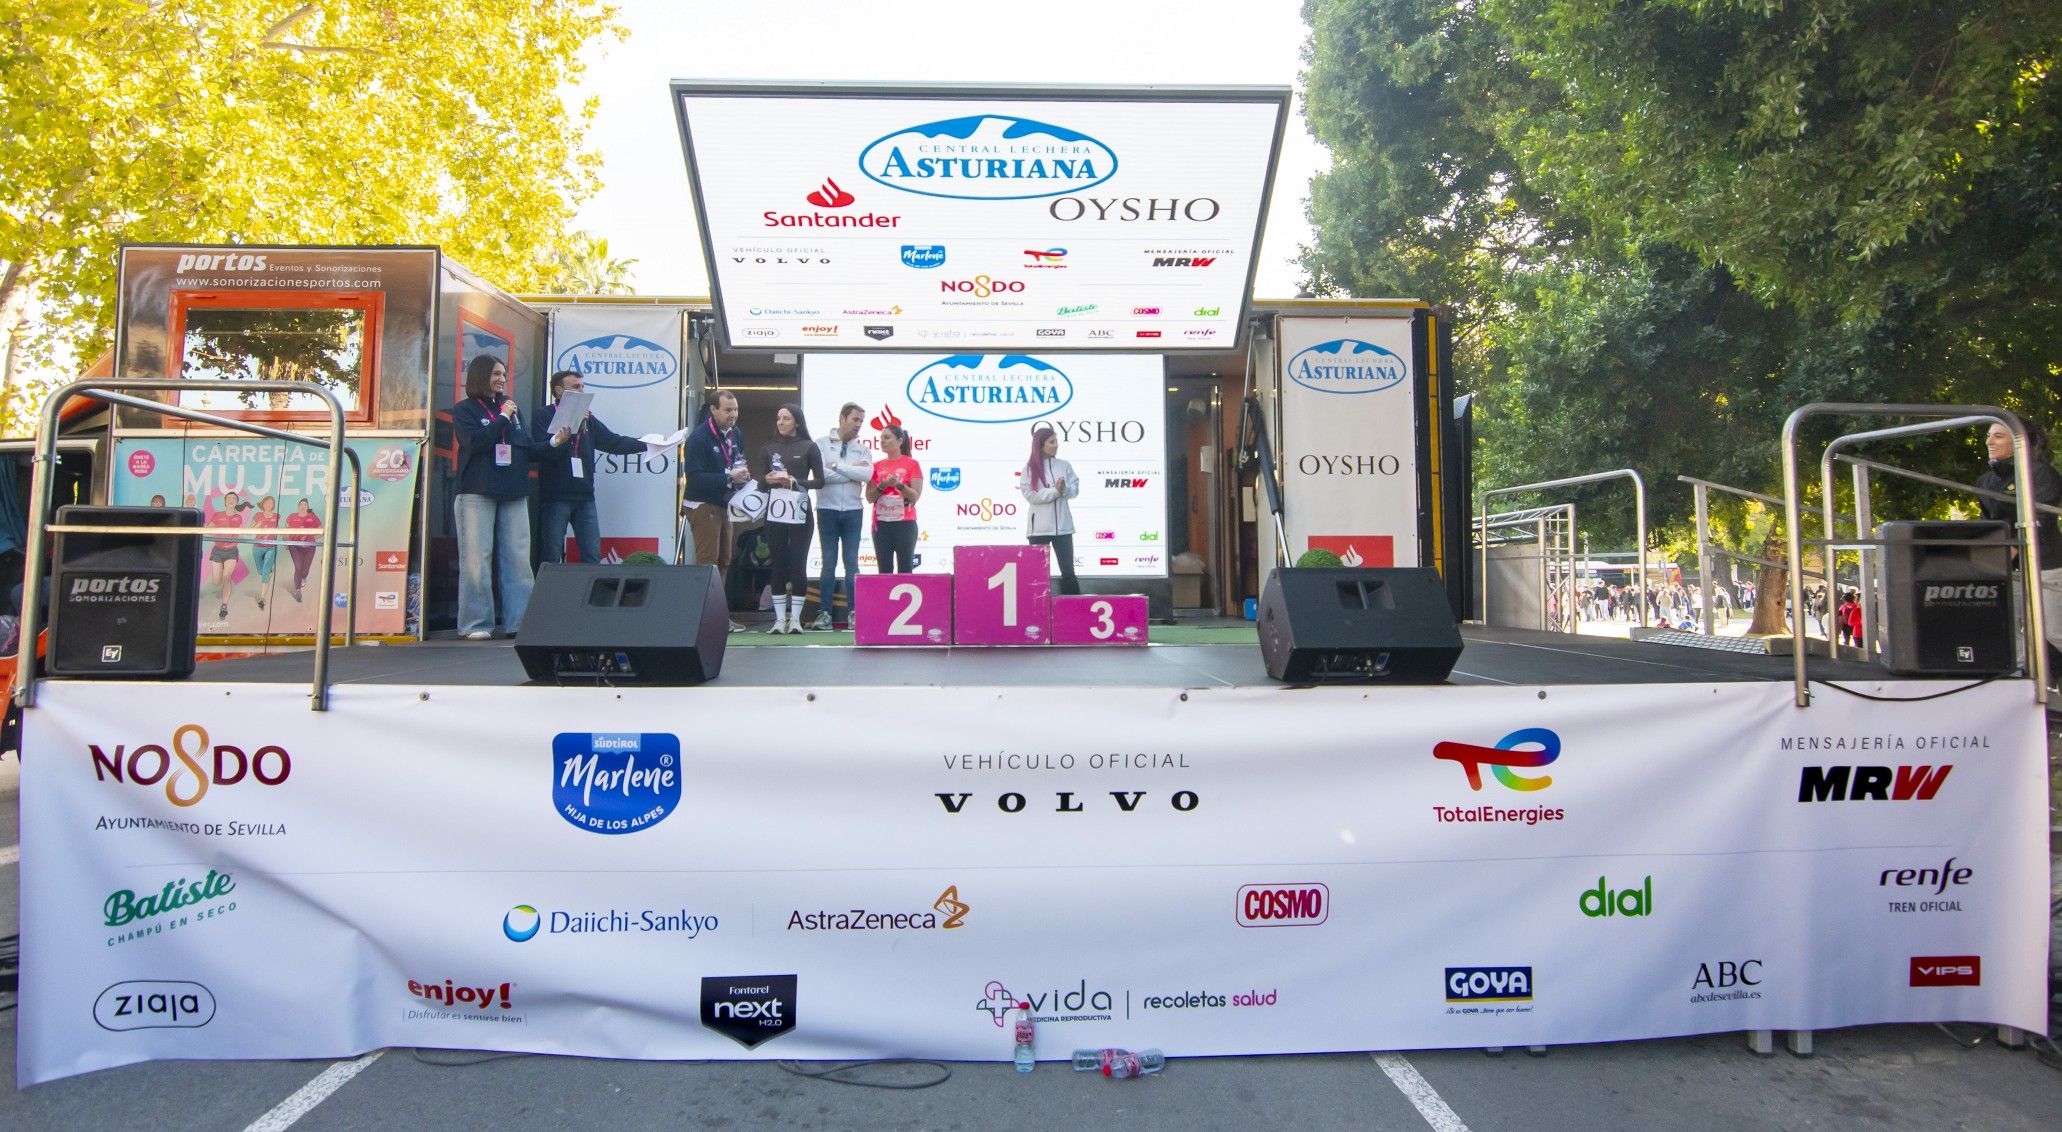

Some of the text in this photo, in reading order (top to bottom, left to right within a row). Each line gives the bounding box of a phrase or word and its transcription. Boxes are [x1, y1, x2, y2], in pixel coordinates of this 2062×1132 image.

[918, 144, 1092, 155] CENTRAL LECHERA
[879, 146, 1099, 180] ASTURIANA
[764, 210, 901, 229] Santander
[1049, 197, 1221, 222] OYSHO
[176, 253, 382, 274] portos Eventos y Sonorizaciones
[732, 257, 831, 265] VOLVO
[1152, 257, 1217, 267] MRW
[176, 277, 382, 289] www.sonorizacionesportos.com
[764, 308, 821, 317] Daiichi-Sankyo
[841, 308, 893, 316] AstraZeneca
[1132, 307, 1160, 315] COSMO
[1192, 307, 1220, 317] dial
[801, 325, 839, 335] enjoy!
[1088, 329, 1114, 337] ABC
[568, 353, 668, 375] ASTURIANA
[1297, 358, 1399, 380] ASTURIANA
[1001, 374, 1056, 382] LECHERA
[919, 375, 1061, 404] ASTURIANA
[192, 444, 325, 463] CARRERA DE
[1299, 454, 1400, 476] OYSHO
[184, 464, 329, 496] MUJER
[1104, 478, 1149, 488] MRW
[1139, 530, 1159, 541] dial
[71, 576, 161, 595] portos
[987, 562, 1017, 627] 1
[1924, 583, 1999, 602] portos
[887, 583, 923, 636] 2
[1089, 600, 1115, 639] 3
[1780, 734, 1992, 750] MENSAJERÍA OFICIAL
[943, 750, 1191, 770] VEHÍCULO OFICIAL
[1797, 764, 1954, 803] MRW
[934, 790, 1200, 813] VOLVO
[96, 815, 287, 836] AYUNTAMIENTO DE SEVILLA
[564, 803, 665, 830] HIJA DE LOS ALPES
[1432, 804, 1565, 826] TotalEnergies
[1879, 856, 1973, 896] renfe
[103, 869, 237, 927] Batiste
[1243, 888, 1322, 921] COSMO
[1578, 874, 1652, 918] dial
[1888, 900, 1963, 913] TREN OFICIAL
[107, 901, 237, 947] CHAMPÚ EN SECO
[549, 908, 719, 940] Daiichi-Sankyo
[787, 909, 936, 930] AstraZeneca
[1691, 959, 1763, 990] ABC
[1917, 965, 1974, 976] VIPS
[407, 979, 512, 1010] enjoy!
[729, 985, 769, 995] Fontarel
[1449, 971, 1528, 997] GOYA
[1027, 979, 1277, 1013] vida recoletas salud
[1690, 989, 1762, 1004] abcdesevilla.es
[407, 1009, 523, 1023] Disfrutar es sentirse bien
[714, 997, 783, 1018] next
